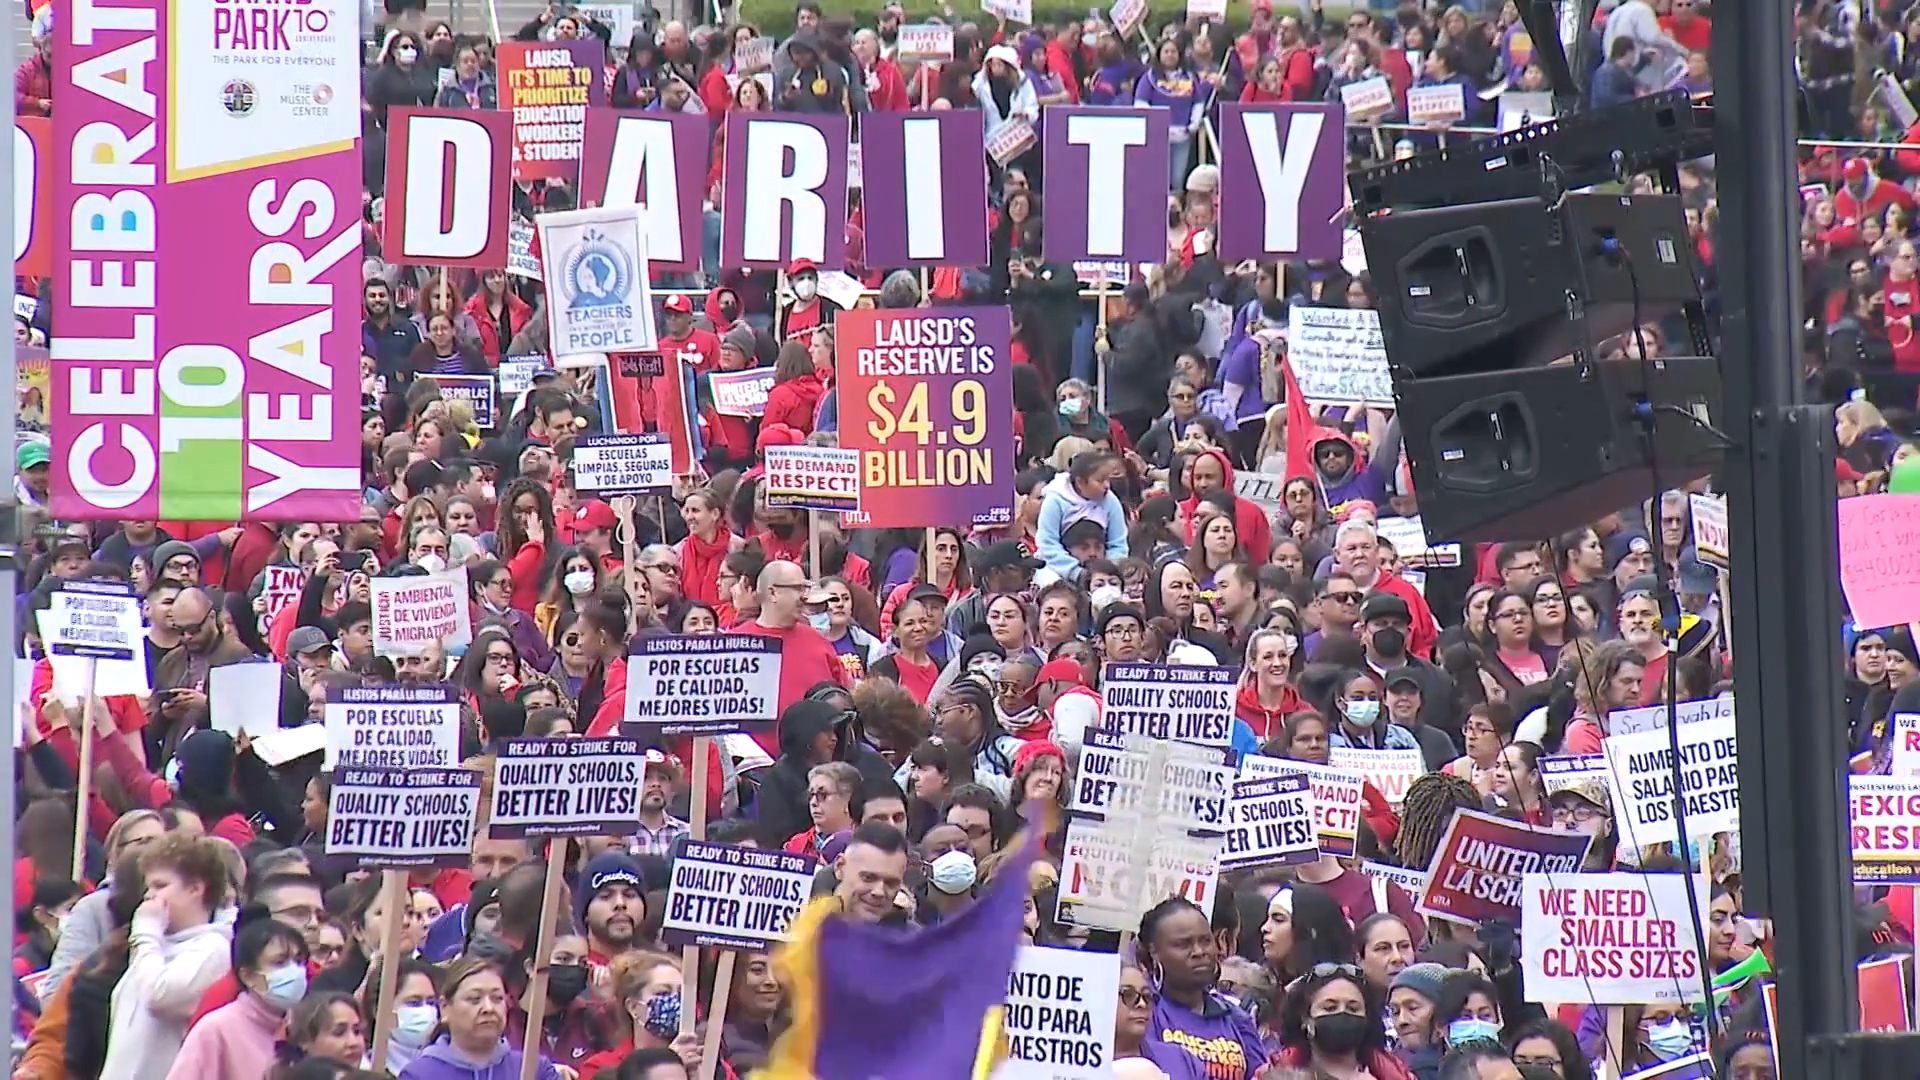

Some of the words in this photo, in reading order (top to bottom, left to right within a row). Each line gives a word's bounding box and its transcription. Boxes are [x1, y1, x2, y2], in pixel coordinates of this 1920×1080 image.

[213, 8, 291, 50] PARK
[902, 30, 949, 41] RESPECT
[915, 41, 937, 49] US!
[213, 55, 229, 64] THE
[233, 55, 258, 64] PARK
[261, 56, 280, 65] FOR
[284, 56, 336, 66] EVERYONE
[508, 69, 535, 87] IT'S
[537, 68, 571, 87] TIME
[575, 67, 592, 84] TO
[293, 84, 310, 94] THE
[513, 86, 589, 105] PRIORITIZE
[280, 95, 310, 105] MUSIC
[292, 106, 328, 116] CENTER
[565, 305, 633, 324] TEACHERS
[569, 329, 633, 348] PEOPLE
[875, 317, 976, 348] LAUSD'S
[248, 177, 361, 513] YEARS
[858, 347, 965, 376] RESERVE
[971, 345, 995, 374] IS
[158, 344, 246, 453] 10
[471, 387, 489, 399] LAS
[475, 400, 488, 410] LA
[867, 379, 988, 445] $4.9
[587, 437, 637, 446] LUCHANDO
[639, 435, 657, 444] POR
[598, 448, 648, 460] ESCUELAS
[624, 459, 669, 472] SEGURAS
[769, 459, 791, 471] WE
[795, 460, 856, 474] DEMAND
[864, 448, 993, 488] BILLION
[595, 475, 602, 485] Y
[604, 474, 617, 485] DE
[619, 473, 653, 484] APOYO
[770, 473, 857, 492] RESPECT!
[845, 511, 871, 524] UTLA
[394, 585, 454, 604] AMBIENTAL
[394, 609, 410, 622] DE
[411, 603, 457, 622] VIVIENDA
[394, 620, 457, 642] MIGRATORIA
[685, 640, 712, 651] PARA
[713, 639, 725, 650] LA
[725, 638, 764, 650] HUELGA
[649, 660, 680, 676] POR
[685, 657, 760, 676] ESCUELAS
[1115, 667, 1150, 680] READY
[1153, 668, 1167, 680] TO
[1170, 669, 1207, 682] STRIKE
[1208, 670, 1230, 682] FOR
[655, 679, 676, 696] DE
[679, 677, 749, 696] CALIDAD,
[639, 699, 710, 717] MEJORES
[1107, 687, 1165, 708] QUALITY
[1168, 689, 1232, 712] SCHOOLS,
[346, 709, 377, 726] POR
[381, 709, 443, 726] ESCUELAS
[1104, 711, 1171, 740] BETTER
[1175, 713, 1231, 740] LIVES!
[354, 730, 373, 746] DE
[377, 729, 436, 748] CALIDAD,
[508, 742, 549, 756] READY
[551, 742, 568, 756] TO
[570, 741, 610, 755] STRIKE
[612, 740, 638, 753] FOR
[338, 749, 405, 766] MEJORES
[1713, 737, 1738, 760] DE
[500, 763, 564, 786] QUALITY
[568, 761, 639, 786] SCHOOLS,
[1084, 752, 1149, 782] QUALITY
[1163, 762, 1228, 795] CHOOLS,
[1380, 761, 1417, 771] WAGES
[345, 771, 386, 785] READY
[389, 772, 405, 786] TO
[407, 773, 446, 786] STRIKE
[448, 772, 472, 786] FOR
[1324, 772, 1346, 782] EVERY
[1237, 782, 1275, 797] STRIKE
[1277, 778, 1300, 791] FOR
[336, 793, 400, 815] QUALITY
[403, 793, 471, 817] SCHOOLS,
[496, 789, 570, 817] BETTER
[575, 787, 637, 815] LIVES!
[1241, 797, 1309, 823] SCHOOLS,
[1637, 801, 1669, 824] LOS
[331, 818, 406, 847] BETTER
[411, 819, 470, 848] LIVES!
[1255, 818, 1313, 850] LIVES!
[686, 844, 726, 861] READY
[726, 849, 742, 863] TO
[742, 852, 779, 867] STRIKE
[780, 856, 805, 872] FOR
[1455, 835, 1539, 878] UNITED
[1541, 853, 1577, 874] FOR
[1159, 857, 1214, 876] WAGES
[676, 866, 735, 894] QUALITY
[739, 875, 804, 906] SCHOOLS,
[1443, 864, 1475, 894] LA
[1474, 873, 1523, 908] SCH
[670, 892, 741, 928] BETTER
[1538, 888, 1577, 916] WE
[1584, 889, 1646, 917] NEED
[1560, 918, 1676, 948] SMALLER
[1543, 948, 1623, 979] CLASS
[1629, 950, 1696, 979] SIZES
[1008, 971, 1052, 999] NTO
[1056, 975, 1084, 1002] DE
[1038, 1006, 1092, 1037] PARA
[1008, 1034, 1103, 1068] AESTROS
